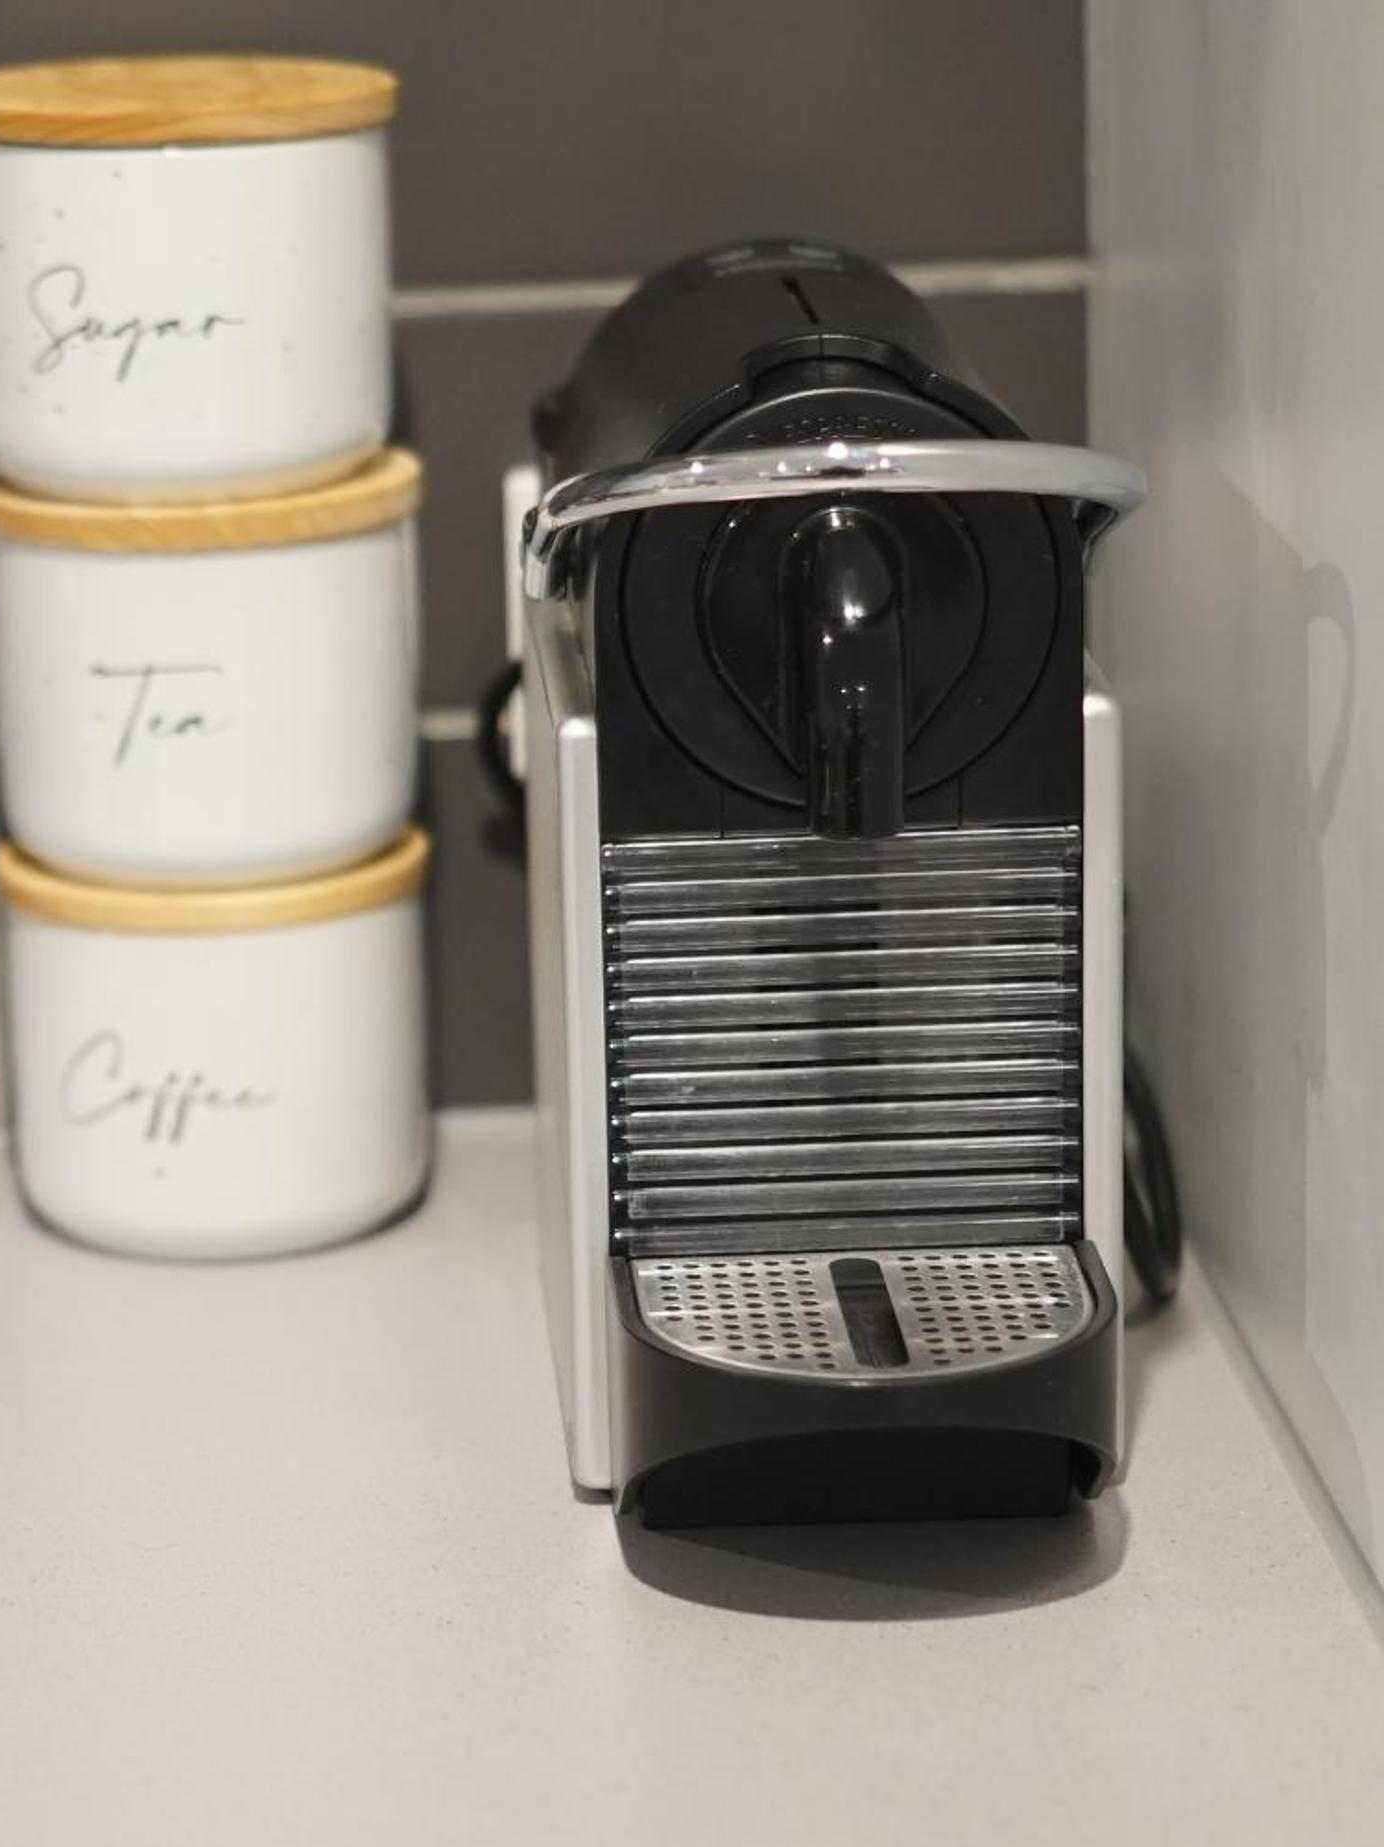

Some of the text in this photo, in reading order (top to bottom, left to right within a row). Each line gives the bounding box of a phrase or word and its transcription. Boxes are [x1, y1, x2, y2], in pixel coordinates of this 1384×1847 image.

[27, 264, 246, 382] Sugar
[89, 663, 231, 767] Tea
[61, 1030, 274, 1144] Coffee
